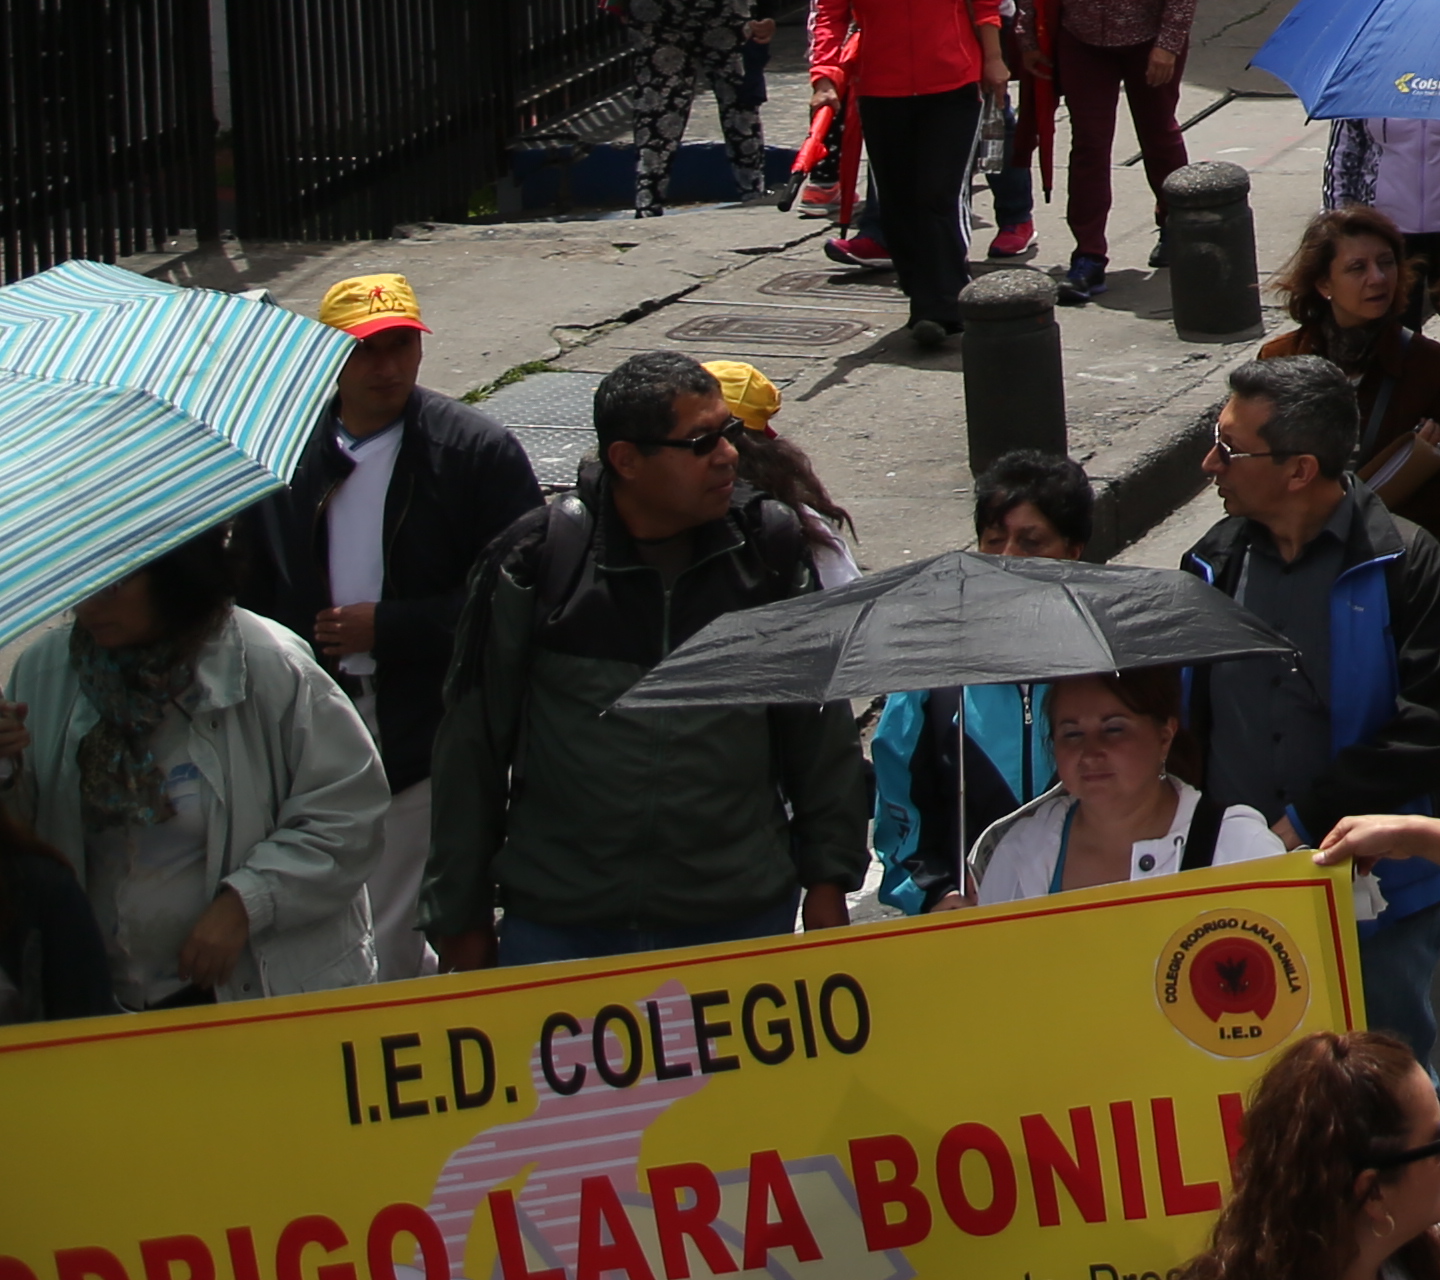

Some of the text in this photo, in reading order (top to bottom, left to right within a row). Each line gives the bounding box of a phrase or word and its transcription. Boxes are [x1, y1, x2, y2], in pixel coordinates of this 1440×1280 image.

[1180, 918, 1239, 952] RODRIGO
[341, 972, 871, 1127] I.E.D. COLEGIO
[1219, 1025, 1263, 1040] I.E.D
[487, 1148, 823, 1280] LARA
